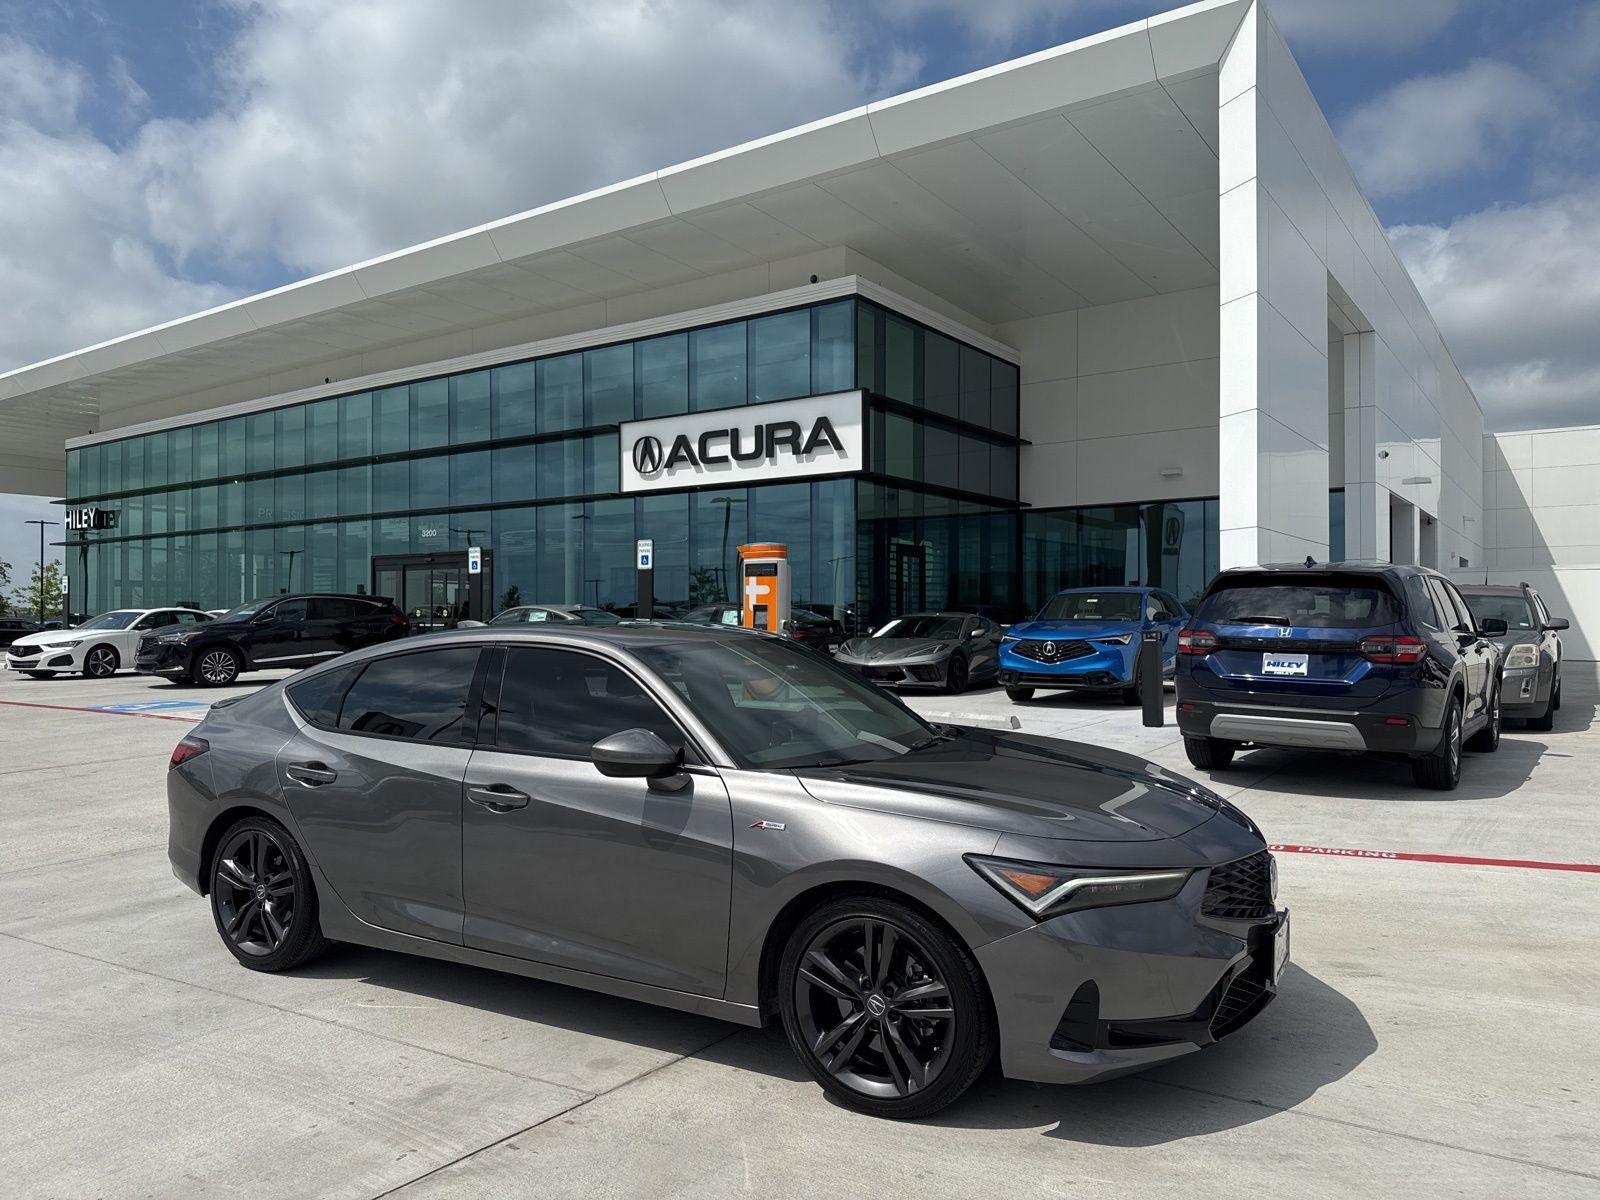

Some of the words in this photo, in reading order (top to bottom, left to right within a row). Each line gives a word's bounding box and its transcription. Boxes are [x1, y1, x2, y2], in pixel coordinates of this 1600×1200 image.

[664, 416, 845, 469] ACURA
[65, 507, 96, 529] HILEY
[421, 529, 437, 537] 3200
[1298, 846, 1397, 858] PARKING
